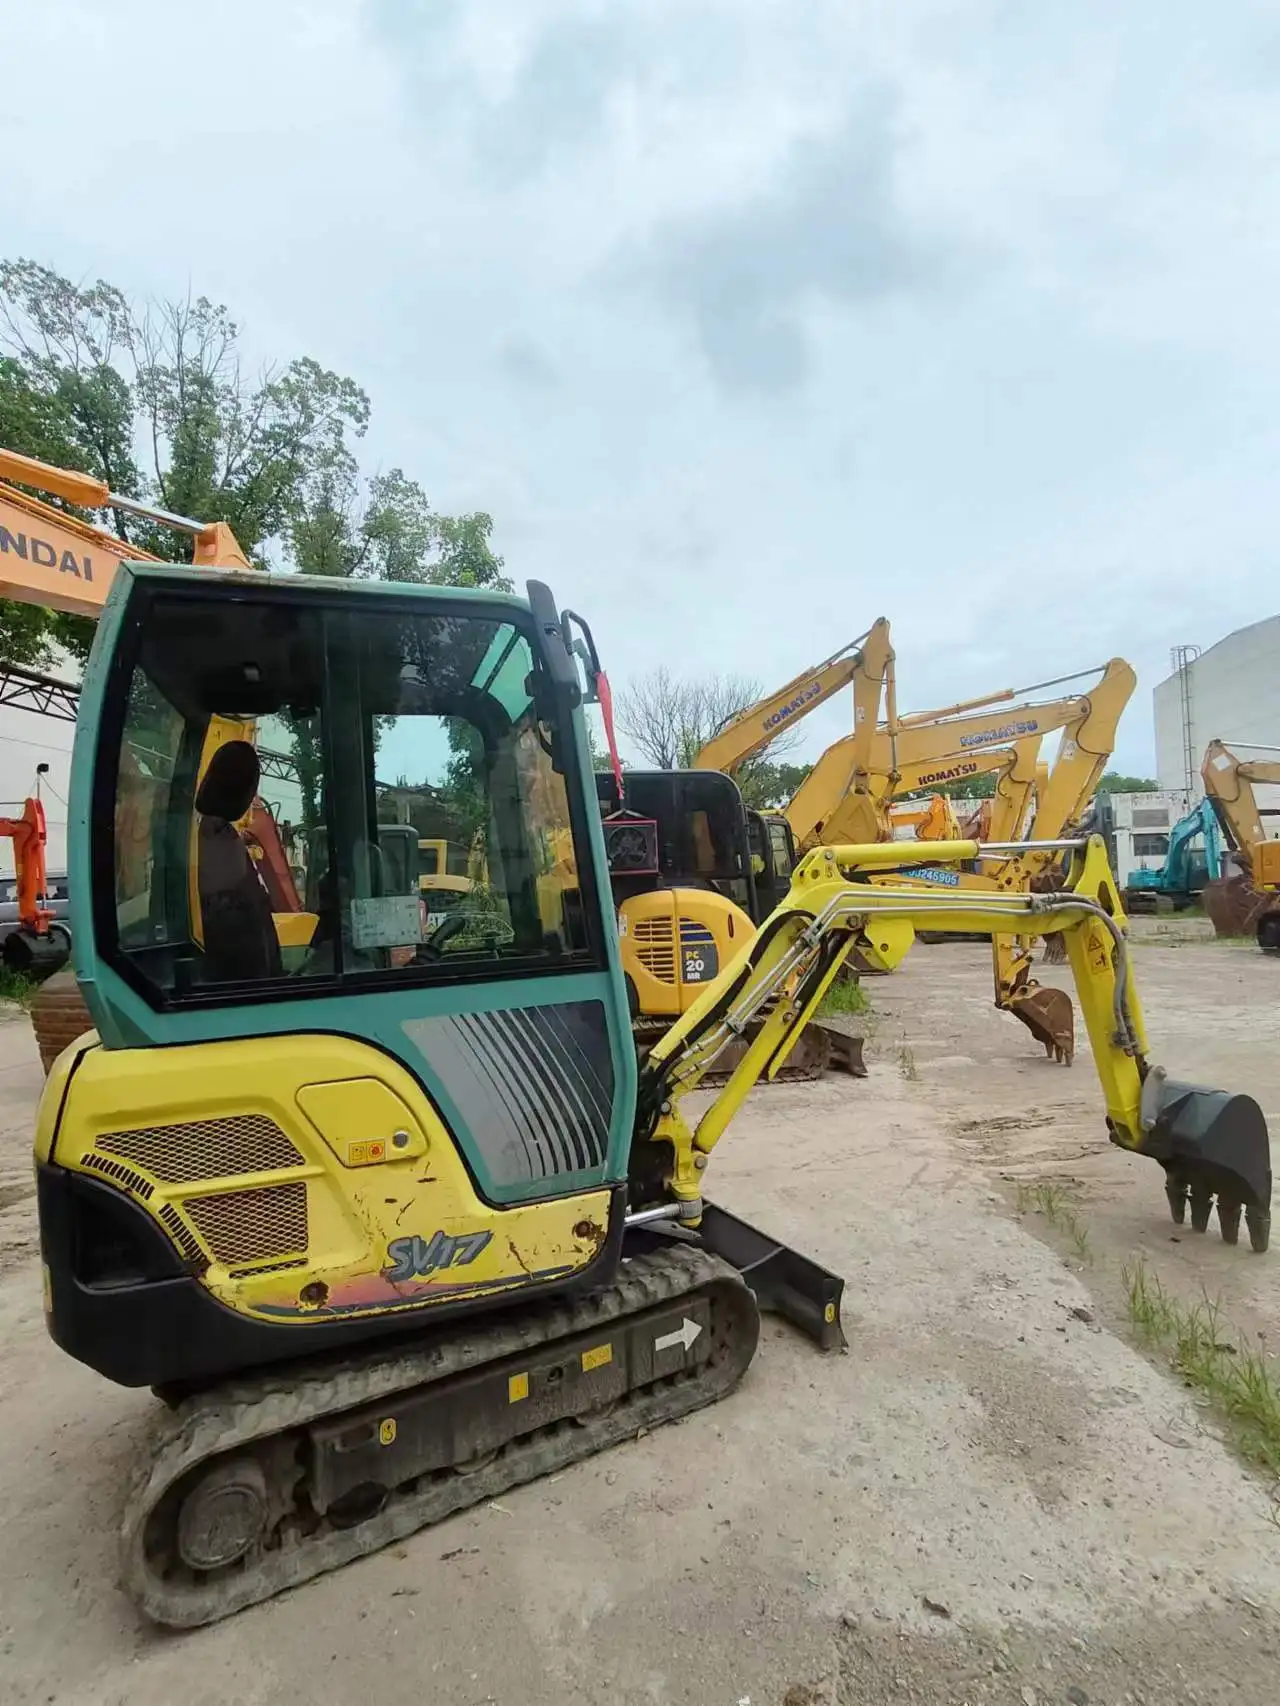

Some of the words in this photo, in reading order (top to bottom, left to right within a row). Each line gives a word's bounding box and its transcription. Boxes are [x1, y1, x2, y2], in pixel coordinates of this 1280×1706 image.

[763, 681, 821, 731] KOMATSU
[960, 720, 1038, 746] KOMATSU
[918, 763, 977, 785] KOMATSU
[686, 951, 700, 960] PC
[686, 960, 704, 971] 20
[687, 972, 700, 980] MR
[386, 1230, 493, 1282] SV17
